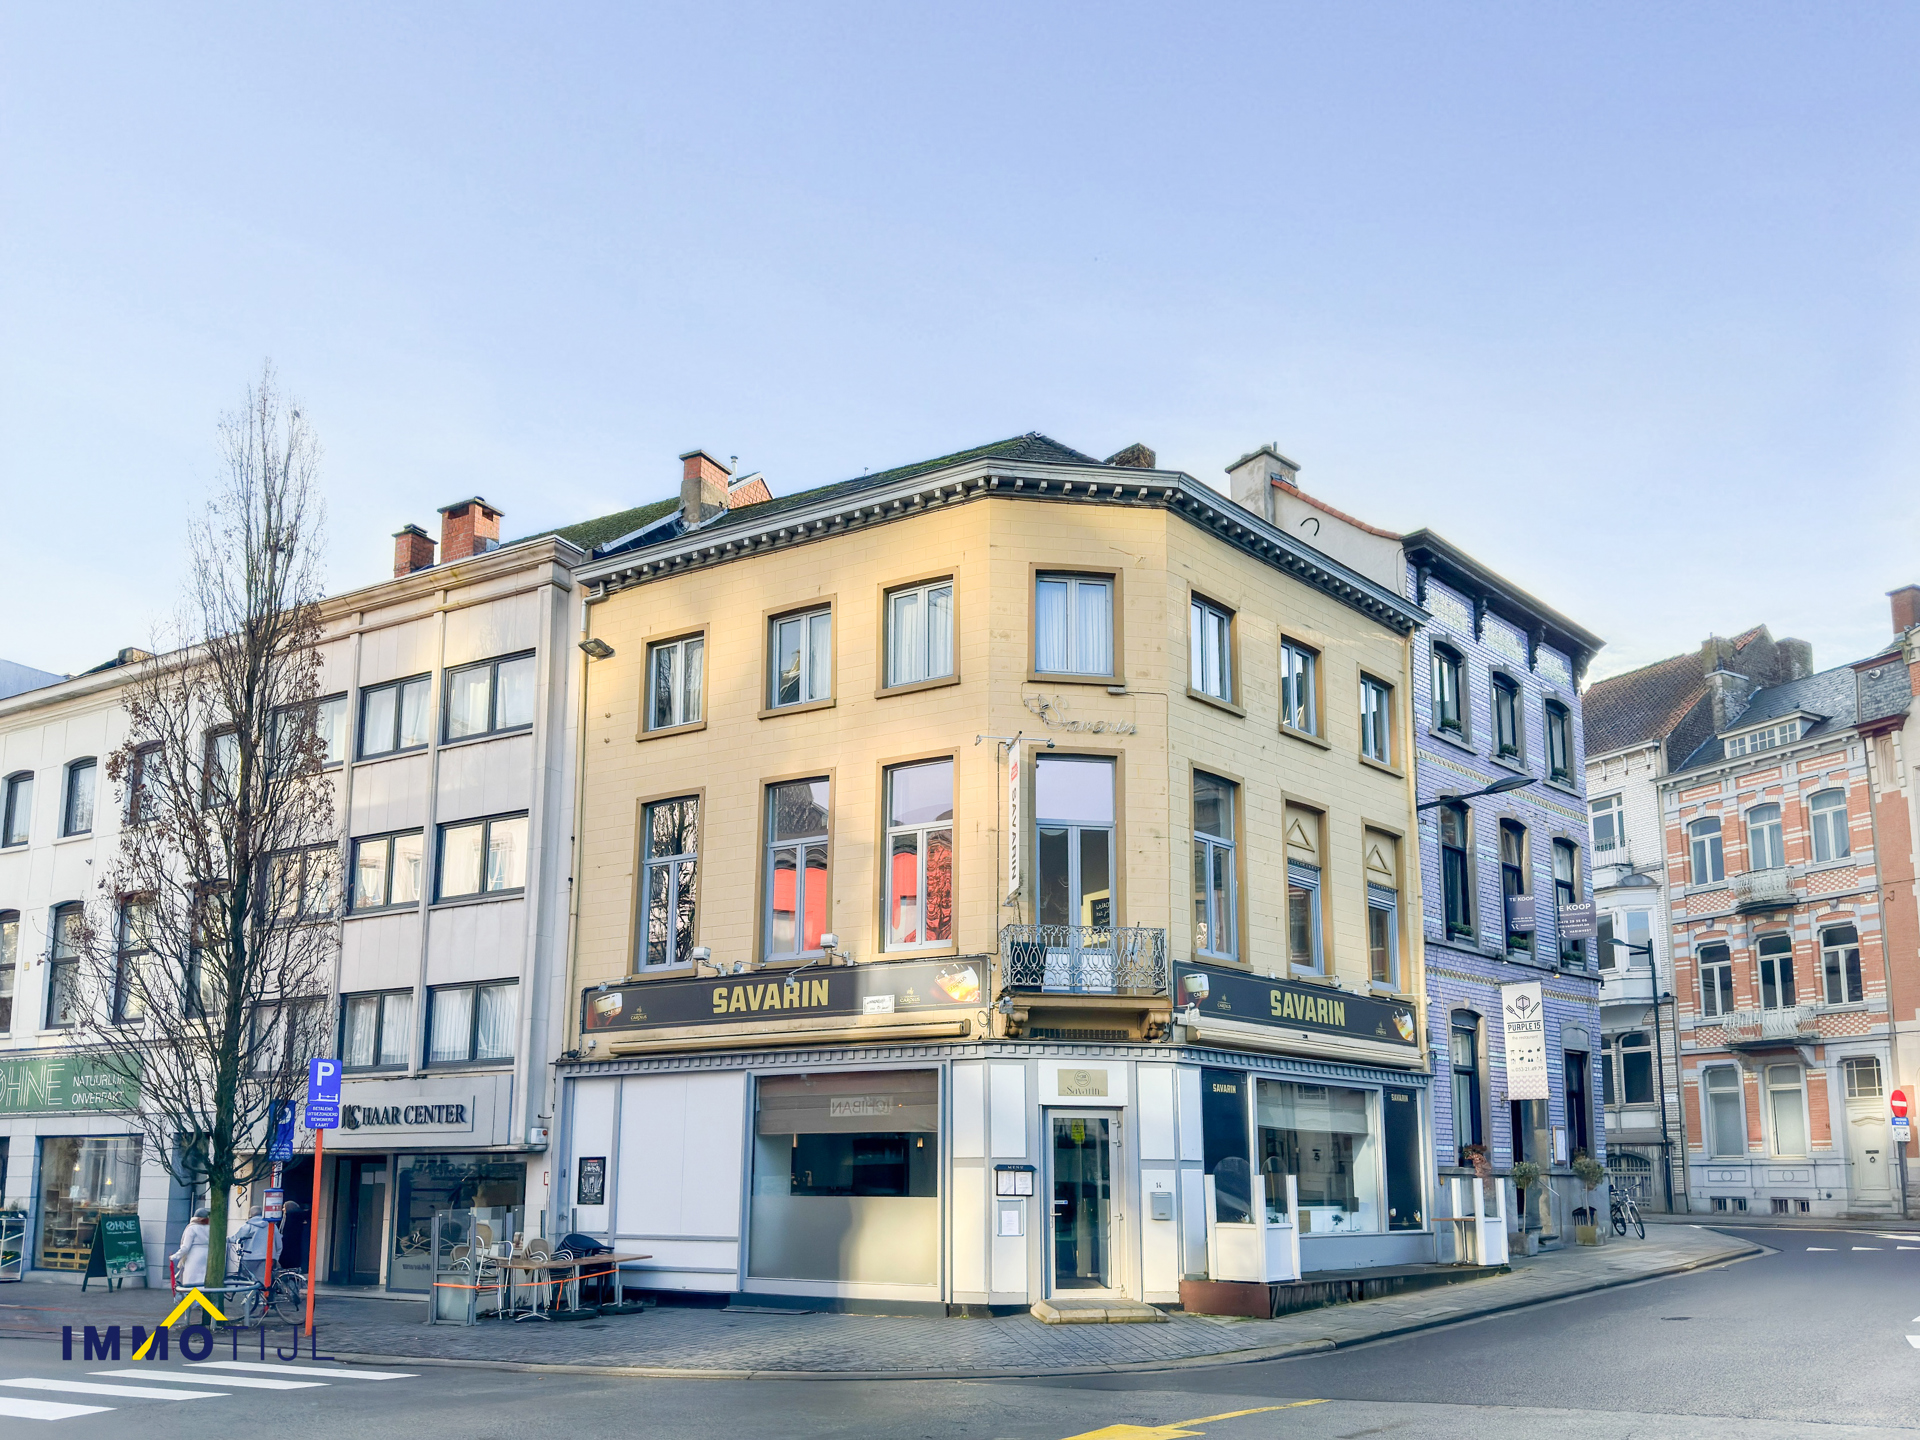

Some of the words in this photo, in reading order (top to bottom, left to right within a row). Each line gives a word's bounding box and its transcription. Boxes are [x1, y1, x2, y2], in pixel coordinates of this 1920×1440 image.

[1566, 903, 1591, 912] KOOP
[713, 979, 829, 1014] SAVARIN
[1270, 989, 1346, 1027] SAVARIN
[1507, 1022, 1533, 1032] PURPLE
[1534, 1021, 1541, 1030] 15
[316, 1061, 335, 1087] P
[1212, 1083, 1237, 1094] SAVARIN
[362, 1105, 401, 1126] HAAR
[403, 1103, 467, 1125] CENTER
